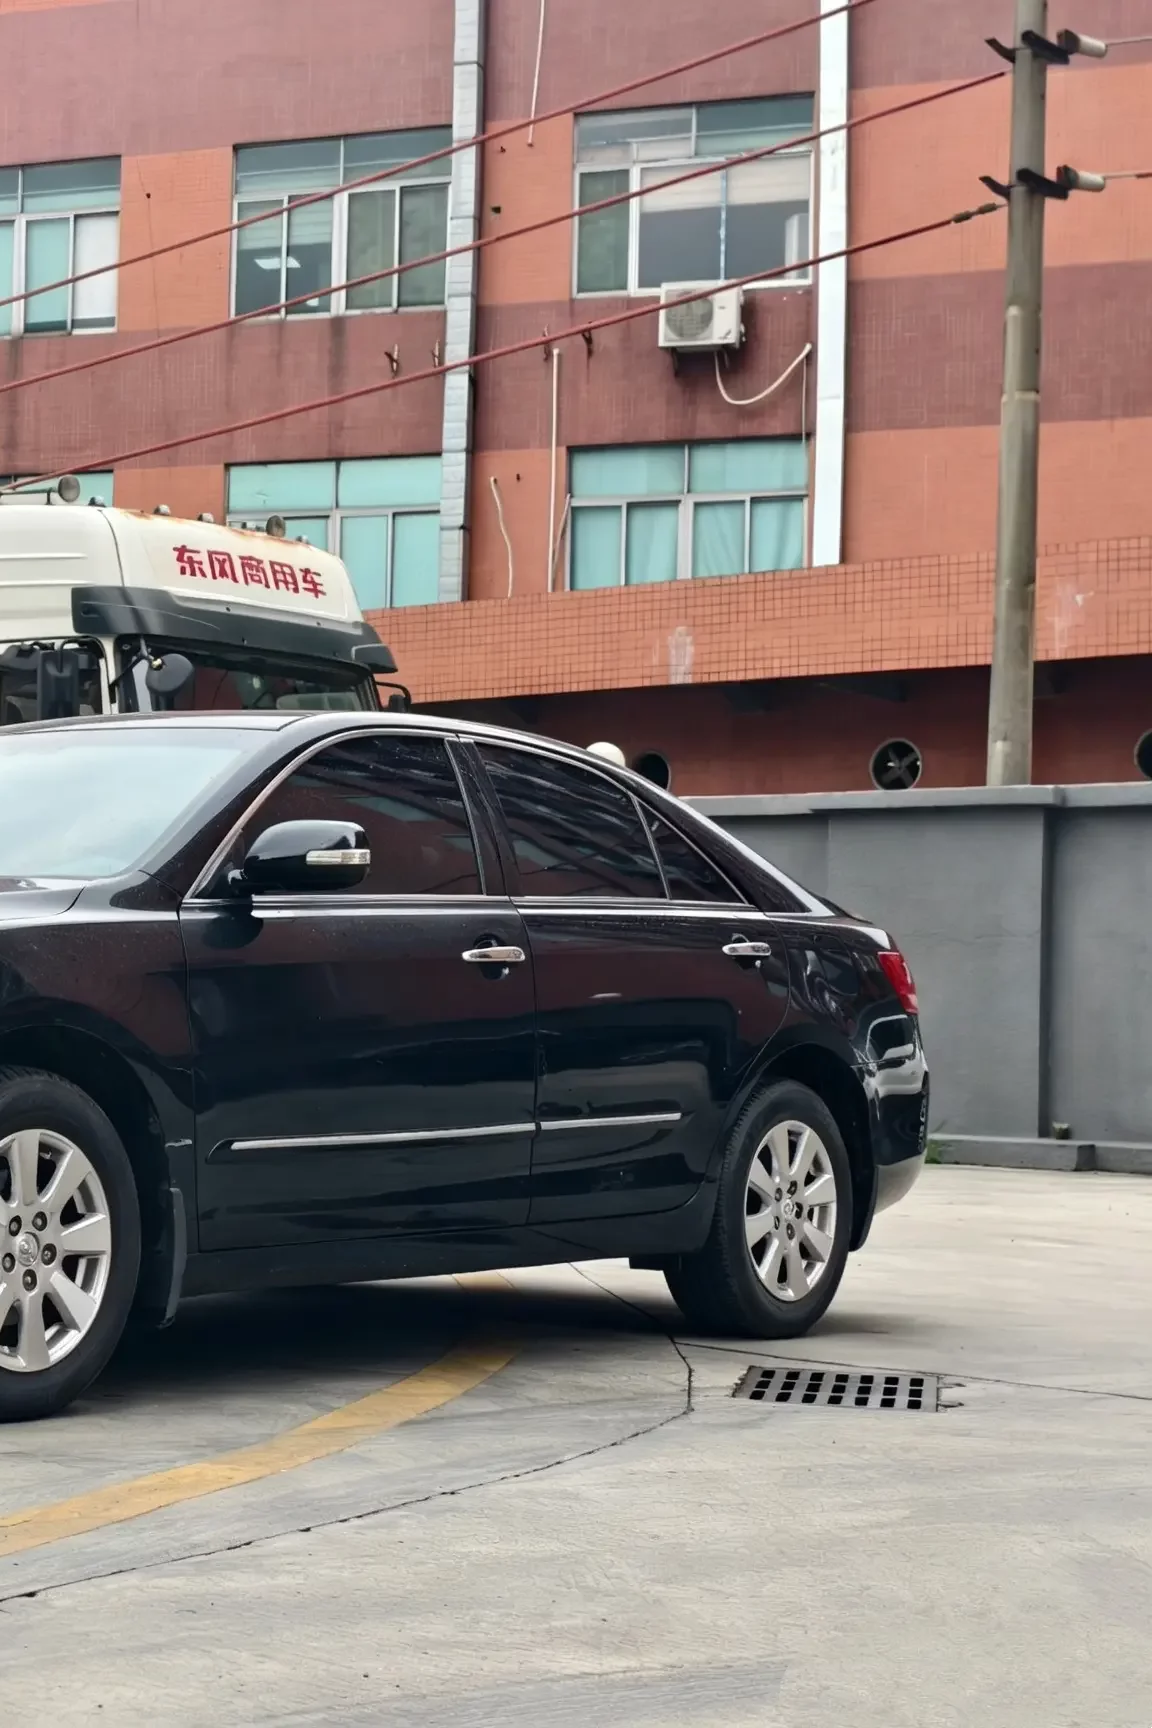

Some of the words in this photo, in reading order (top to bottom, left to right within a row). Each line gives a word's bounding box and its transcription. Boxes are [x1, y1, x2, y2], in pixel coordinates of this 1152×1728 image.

[172, 544, 327, 599] 东风商用车
